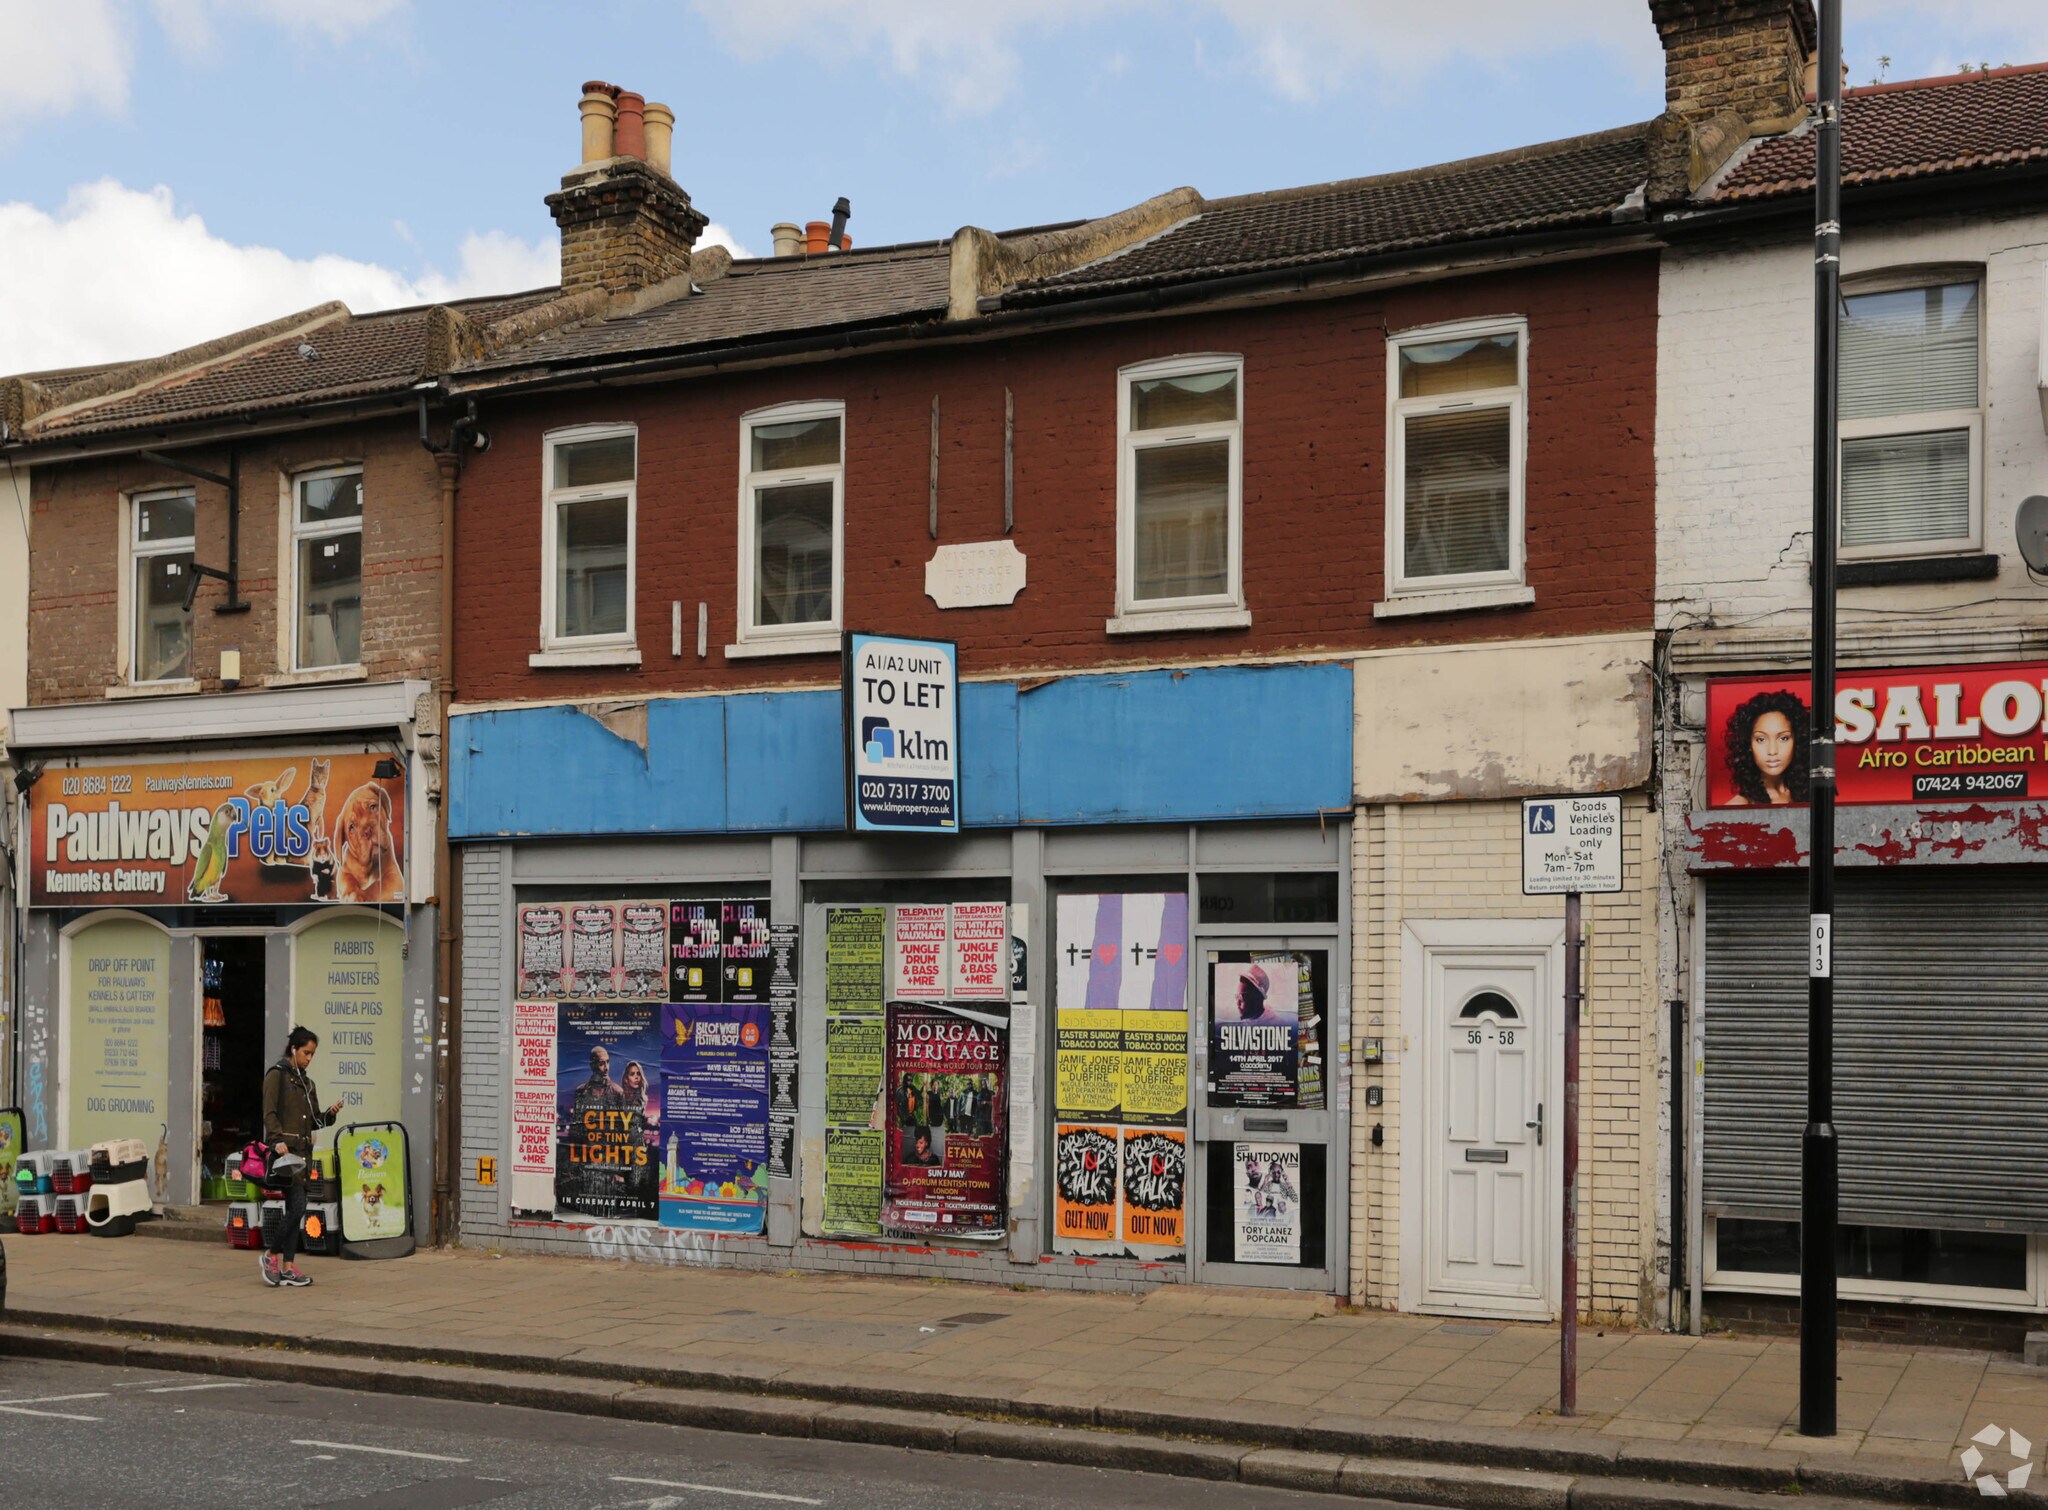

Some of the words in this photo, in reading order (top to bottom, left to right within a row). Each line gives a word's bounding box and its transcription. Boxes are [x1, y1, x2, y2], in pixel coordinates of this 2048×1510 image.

[908, 658, 942, 675] UNIT
[862, 678, 895, 704] TO
[904, 681, 945, 708] LET
[1834, 680, 2048, 744] SALO
[899, 729, 949, 760] klm
[1858, 748, 1908, 769] Afro
[1915, 743, 2036, 766] Caribbean
[62, 776, 81, 795] 020
[82, 777, 107, 794] 8684
[109, 775, 132, 793] 1222
[145, 775, 233, 793] PaulwaysKennels.com
[1916, 776, 1961, 792] 07424
[1966, 774, 2024, 790] 942067
[862, 782, 885, 799] 020
[888, 783, 918, 800] 7317
[921, 784, 950, 801] 3700
[863, 801, 950, 815] www.klmproperty.co.uk
[1572, 801, 1607, 812] Goods
[1569, 813, 1615, 824] Vehicles
[46, 801, 210, 865] Paulways
[227, 797, 310, 858] Pets
[1569, 825, 1612, 836] Loading
[1579, 838, 1602, 849] only
[1545, 852, 1566, 862] Mon
[1575, 851, 1593, 861] Sat
[1544, 863, 1565, 873] 7am
[1574, 863, 1595, 873] 7pm
[46, 868, 101, 893] Kennels
[102, 871, 113, 891] &
[114, 867, 165, 893] Cattery
[672, 905, 705, 923] CLUB
[897, 908, 945, 916] TELEPATHY
[898, 930, 944, 940] VAUXHALL
[334, 941, 374, 955] RABBITS
[672, 943, 720, 958] TUESDAY
[900, 944, 940, 954] JUNGLE
[1815, 926, 1825, 971] 013
[88, 958, 111, 972] DROP
[113, 958, 128, 972] OFF
[131, 958, 156, 972] POINT
[905, 955, 936, 964] DRUM
[902, 965, 910, 975] &
[911, 965, 939, 975] BASS
[98, 977, 111, 988] FOR
[112, 977, 145, 988] PAULWAYS
[328, 971, 379, 985] HAMSTERS
[907, 976, 935, 985] +MRE
[88, 990, 118, 1001] KENNELS
[120, 990, 125, 1001] &
[126, 990, 155, 1001] CATTERY
[324, 1001, 358, 1015] GUINEA
[361, 1001, 383, 1015] PIGS
[696, 1022, 708, 1035] ISLE
[708, 1022, 719, 1034] OF
[719, 1022, 740, 1035] WIGHT
[896, 1024, 998, 1043] MORGAN
[332, 1031, 373, 1045] KITTENS
[695, 1034, 721, 1047] FESTIVAL
[721, 1035, 740, 1047] 2017
[1125, 1033, 1154, 1041] EASTER
[1156, 1033, 1186, 1042] SUNDAY
[1220, 1025, 1292, 1051] SILVASTONE
[1467, 1030, 1482, 1045] 56
[1499, 1030, 1514, 1046] 58
[896, 1043, 999, 1061] HERITAGE
[1125, 1042, 1161, 1050] TOBACCO
[1163, 1043, 1186, 1051] DOCK
[1123, 1056, 1152, 1066] JAMIE
[1155, 1058, 1187, 1068] JONES
[1229, 1055, 1246, 1063] 14TH
[1247, 1055, 1267, 1063] APRIL
[1268, 1055, 1284, 1063] 2017
[338, 1061, 366, 1075] BIRDS
[943, 1062, 965, 1070] WORLD
[967, 1062, 983, 1070] TOUR
[984, 1063, 1000, 1071] 2017
[1123, 1065, 1144, 1075] GUY
[1146, 1066, 1185, 1077] GERBER
[1134, 1074, 1174, 1085] DUBFIRE
[342, 1091, 363, 1105] FISH
[87, 1097, 106, 1112] DOG
[108, 1098, 155, 1113] GROOMING
[584, 1110, 633, 1131] CITY
[587, 1132, 602, 1142] OF
[604, 1132, 630, 1143] TINY
[569, 1143, 648, 1166] LIGHTS
[947, 1146, 984, 1159] ETANA
[1236, 1151, 1299, 1164] SHUTDOWN
[480, 1158, 493, 1182] H
[927, 1169, 942, 1178] SUN
[943, 1169, 948, 1178] 7
[949, 1170, 965, 1179] MAY
[911, 1178, 938, 1187] FORUM
[938, 1178, 967, 1188] KENTISH
[969, 1179, 991, 1189] TOWN
[1137, 1174, 1168, 1203] TALK
[933, 1188, 959, 1196] LONDON
[562, 1196, 572, 1204] IN
[575, 1197, 616, 1207] CINEMAS
[619, 1199, 646, 1208] APRIL
[895, 1199, 939, 1208] TICKETWEB.CO.UK
[944, 1203, 997, 1212] TICKETMASTER.CO.UK
[1131, 1215, 1151, 1235] OUT
[1153, 1216, 1177, 1236] NOW
[1241, 1226, 1263, 1234] TORY
[1265, 1227, 1293, 1236] LANEZ
[1246, 1234, 1288, 1244] POPCAAN
